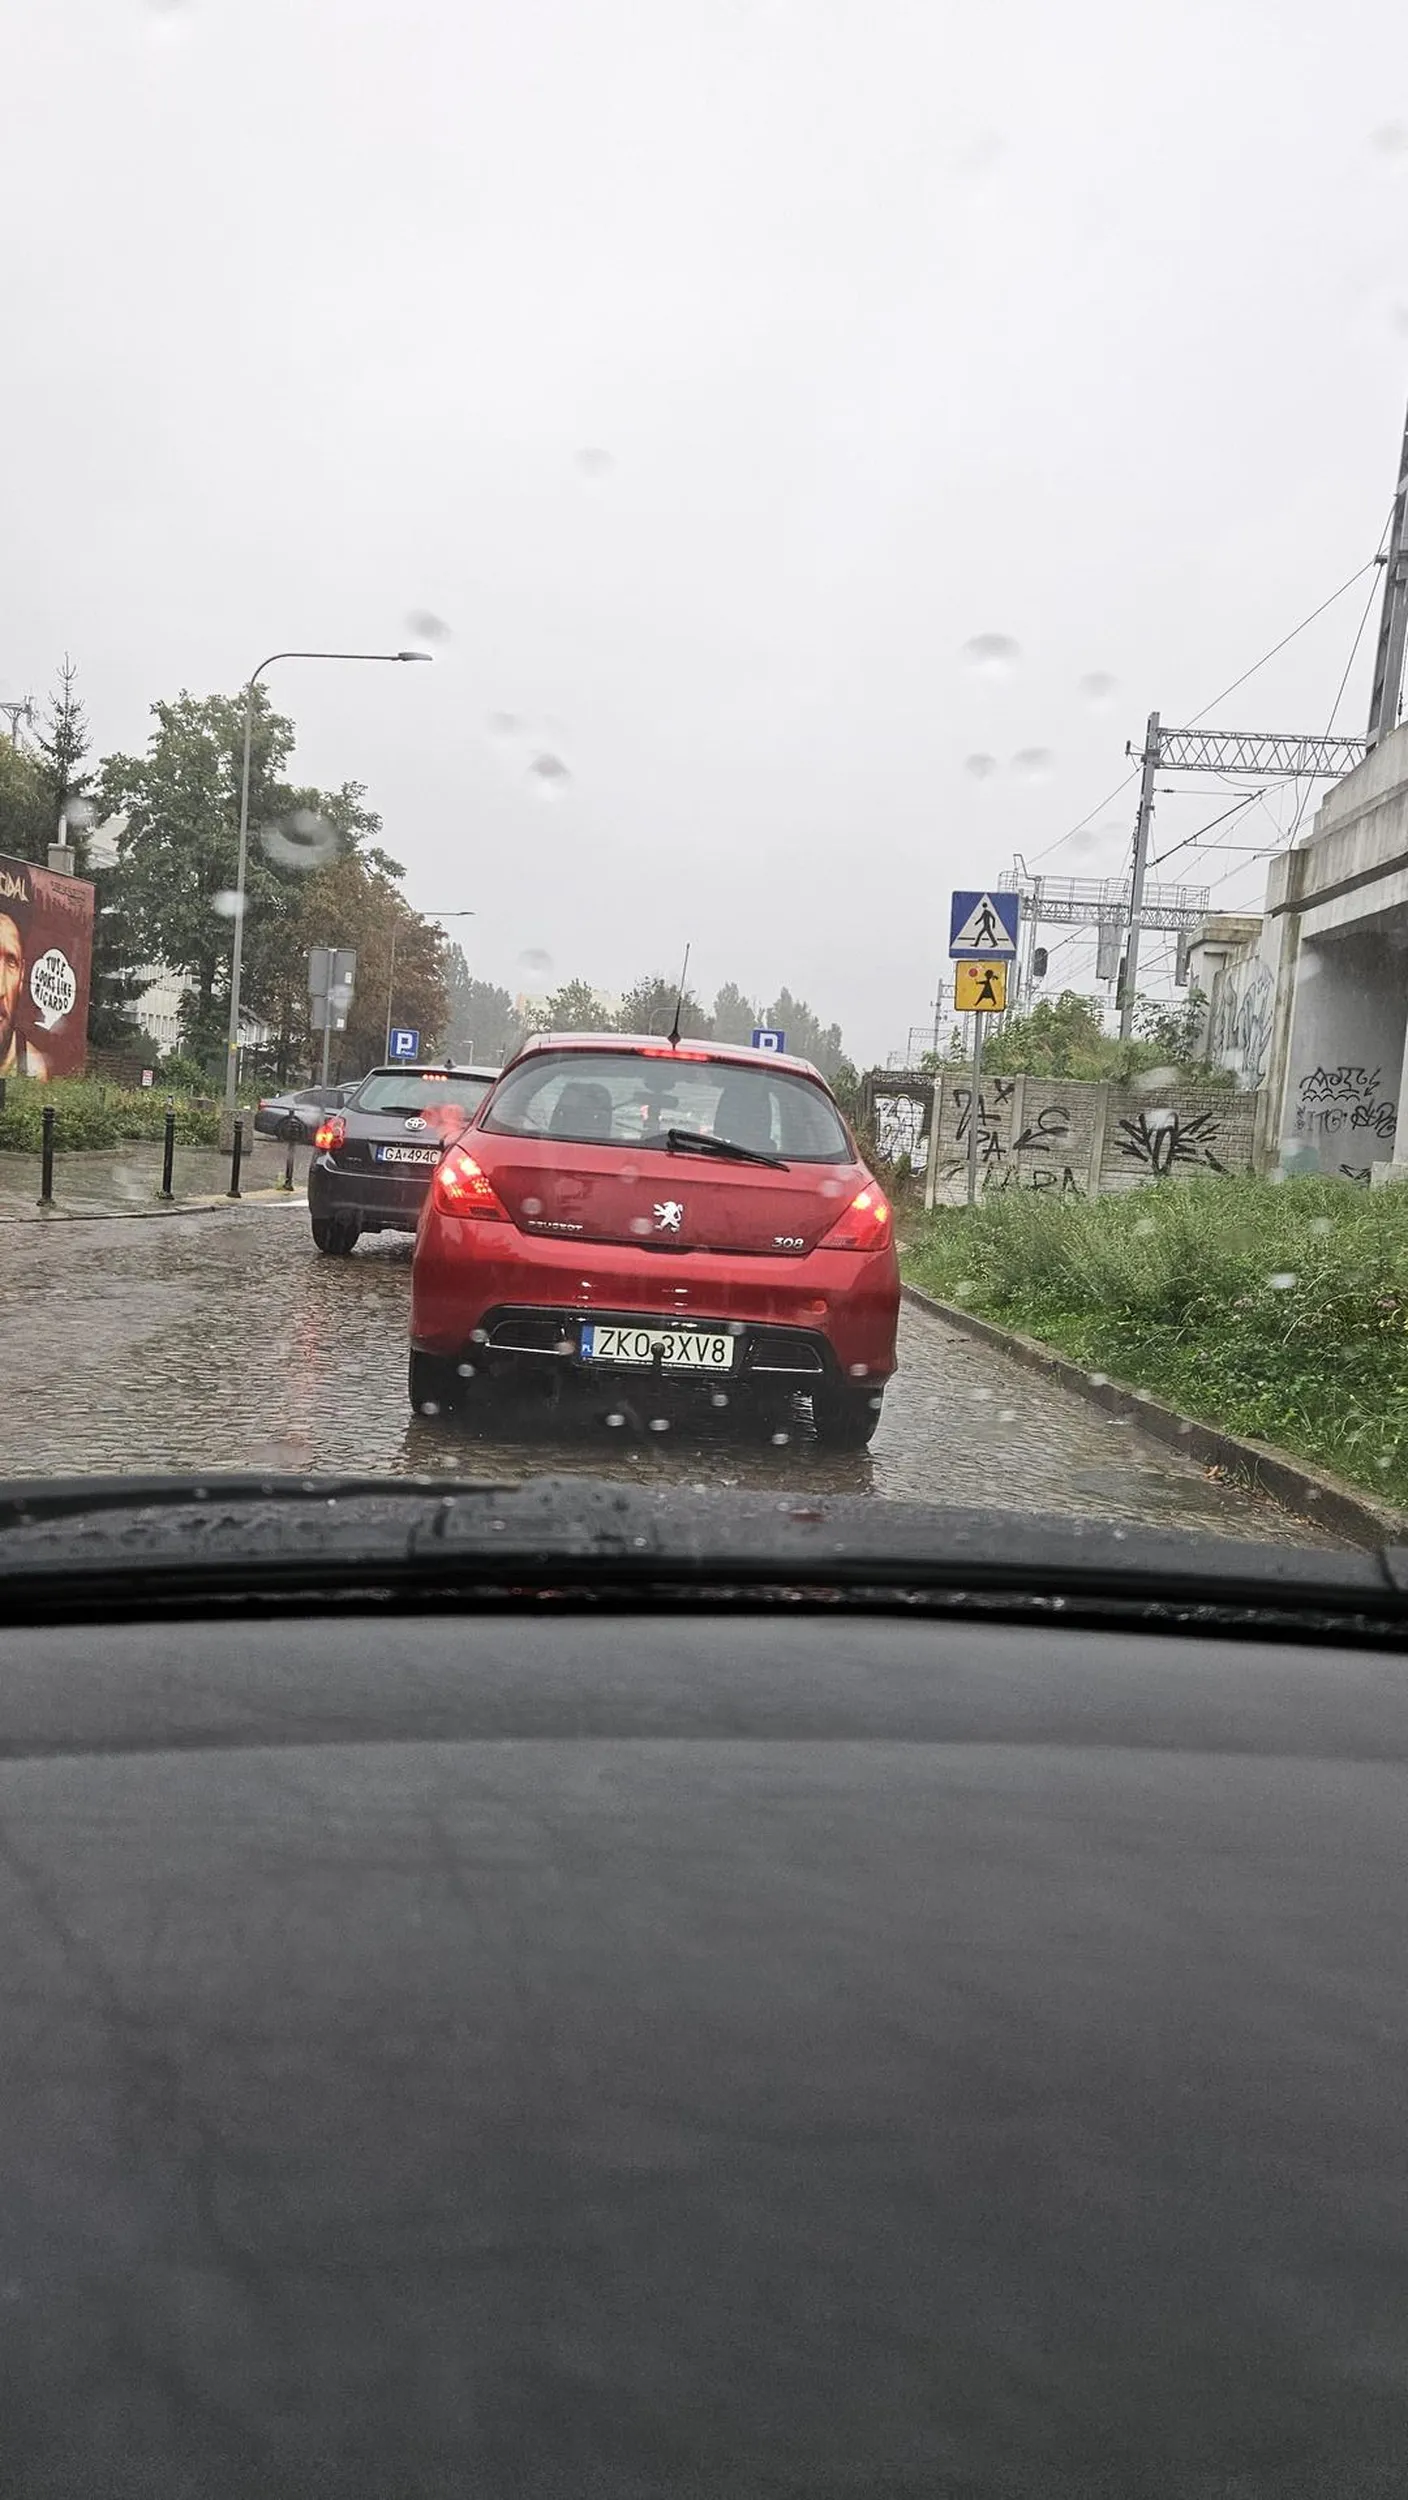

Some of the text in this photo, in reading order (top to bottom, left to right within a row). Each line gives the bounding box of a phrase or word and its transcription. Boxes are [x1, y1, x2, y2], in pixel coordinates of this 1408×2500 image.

[35, 967, 72, 998] LOOKS LIKE
[34, 983, 69, 1011] RICARDO
[396, 1032, 413, 1055] P
[385, 1148, 402, 1161] GA
[771, 1236, 804, 1249] 308
[661, 1334, 725, 1363] 3XV8
